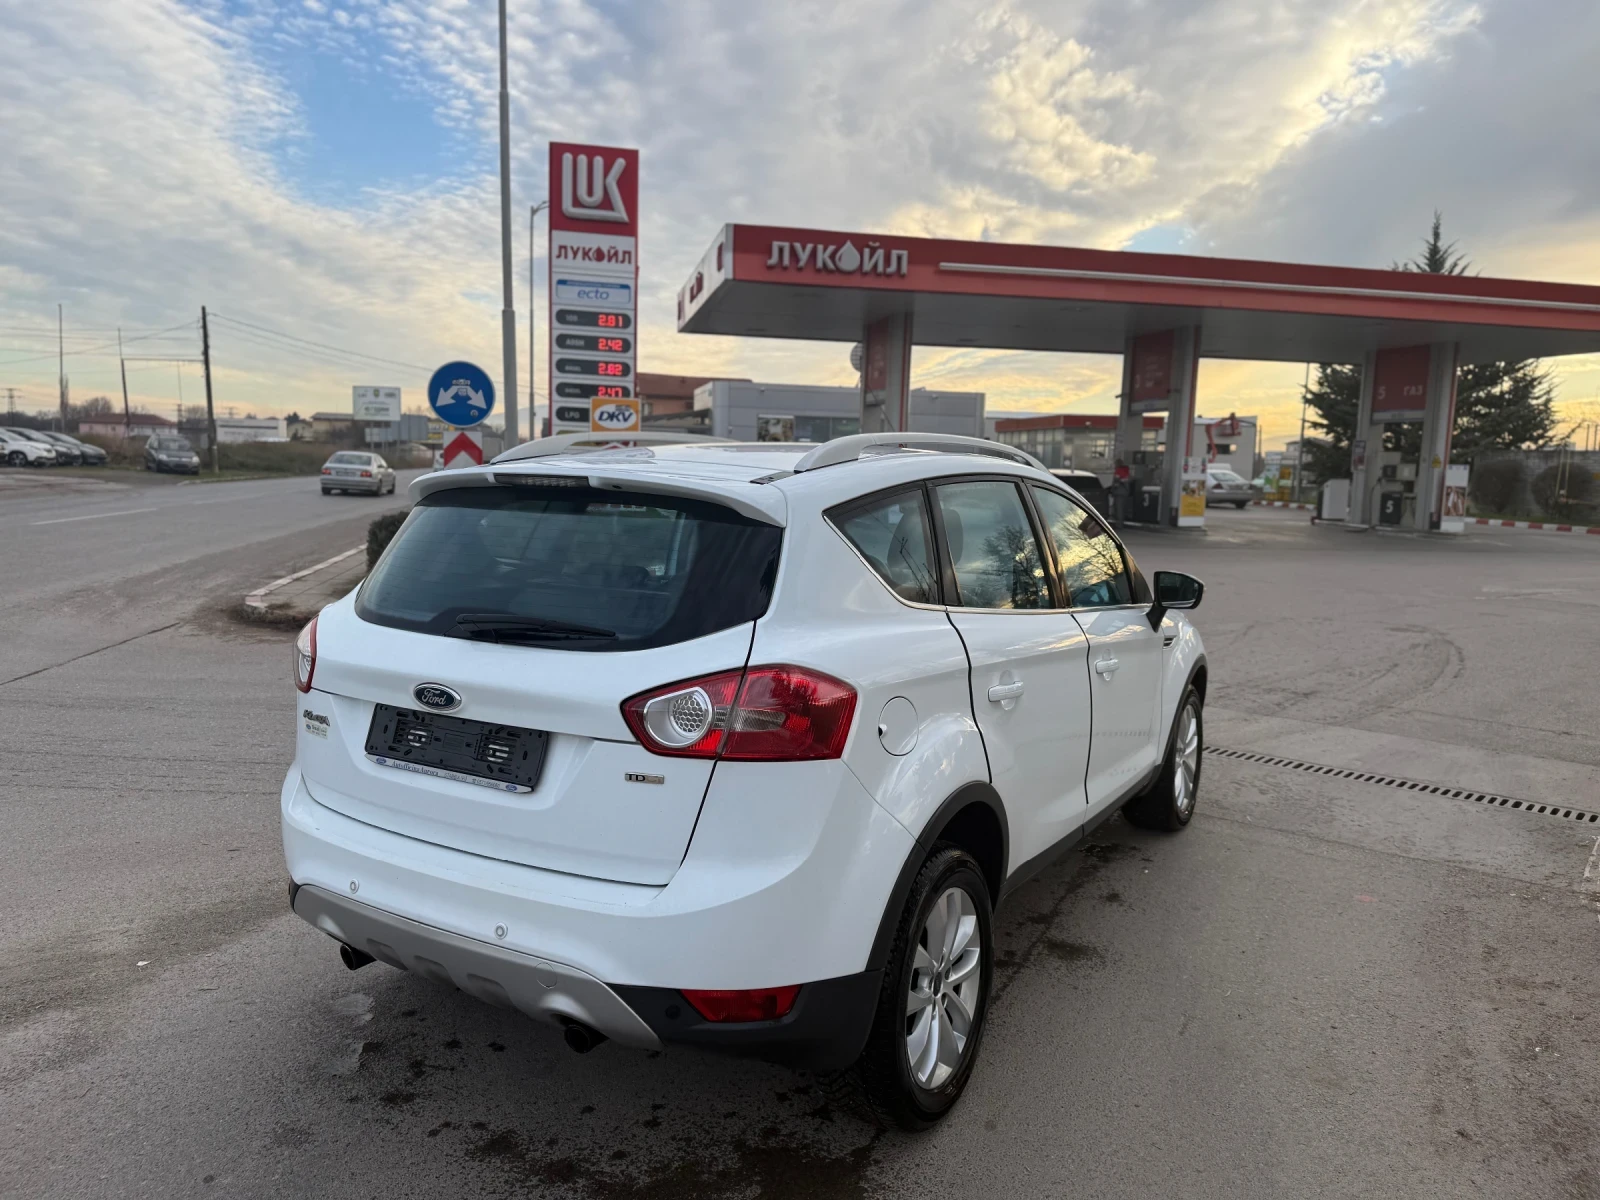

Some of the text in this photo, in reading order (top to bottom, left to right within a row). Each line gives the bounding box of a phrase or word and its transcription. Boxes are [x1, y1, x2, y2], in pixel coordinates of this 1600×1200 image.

[556, 244, 632, 265] ЛУКОЙЛ
[766, 239, 908, 277] ЛУКОЙЛ
[577, 288, 610, 300] ecto
[598, 410, 634, 422] DKV
[1385, 501, 1394, 513] 5
[421, 688, 447, 706] Ford
